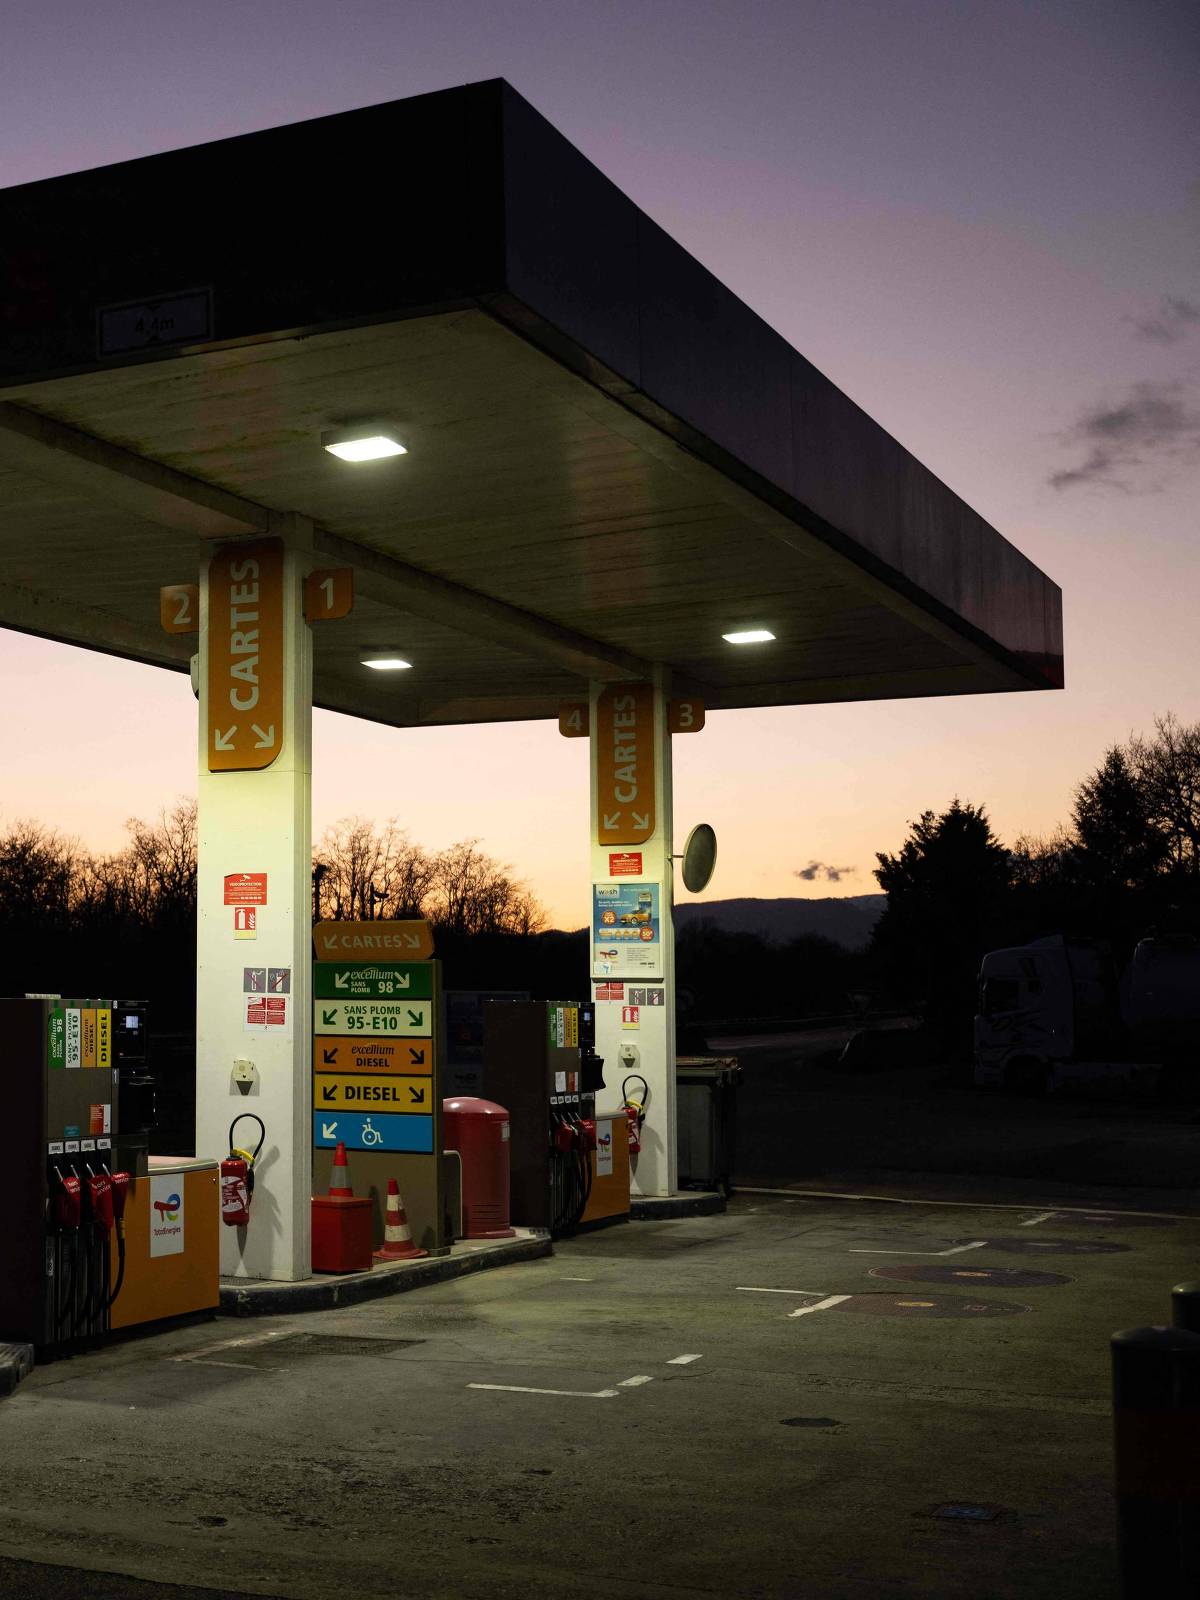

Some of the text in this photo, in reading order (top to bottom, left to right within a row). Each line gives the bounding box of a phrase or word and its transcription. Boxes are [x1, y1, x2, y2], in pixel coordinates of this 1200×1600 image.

[320, 578, 334, 610] 1
[172, 592, 191, 624] 2
[230, 558, 259, 711] CARTES
[567, 709, 583, 732] 4
[679, 703, 694, 727] 3
[613, 694, 637, 803] CARTES
[341, 934, 402, 949] CARTES
[351, 968, 394, 980] excellium
[378, 981, 394, 993] 98
[344, 1006, 401, 1015] SANS PLOMB
[57, 1019, 63, 1033] 98
[347, 1017, 398, 1030] 95-E10
[100, 1013, 108, 1062] DIESEL
[351, 1044, 395, 1055] excellium
[356, 1057, 390, 1067] DIESEL
[345, 1086, 401, 1101] DIESEL
